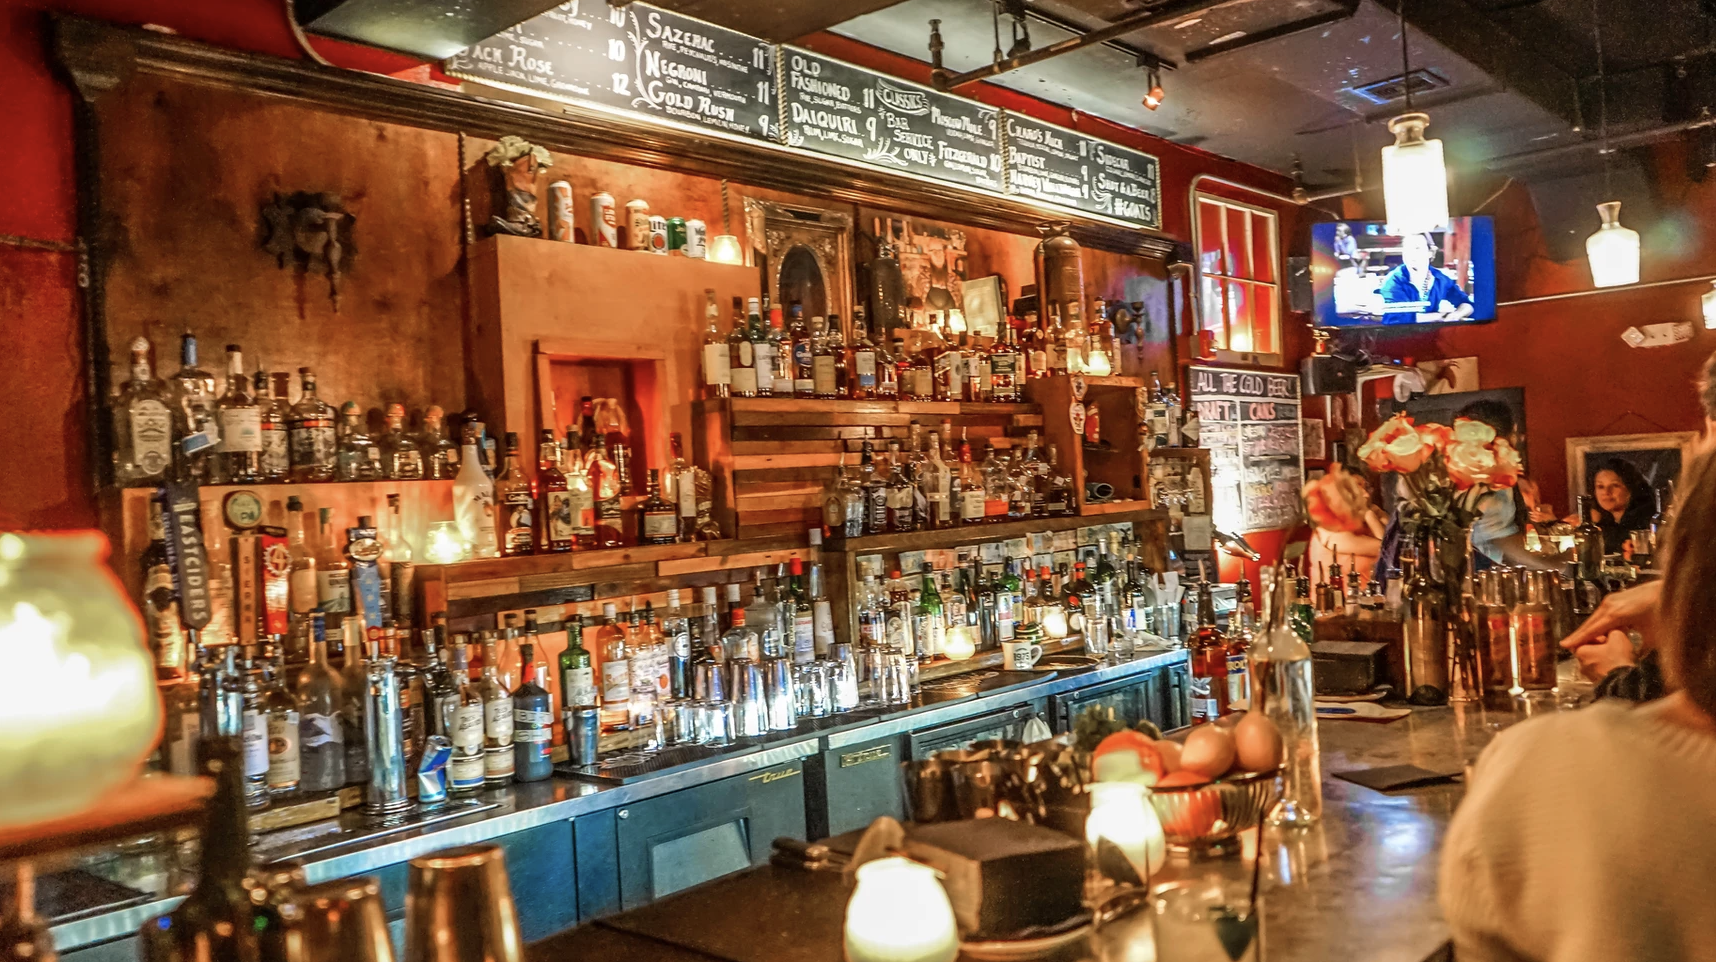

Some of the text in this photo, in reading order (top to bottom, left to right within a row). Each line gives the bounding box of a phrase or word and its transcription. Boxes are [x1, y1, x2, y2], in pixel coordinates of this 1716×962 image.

[608, 39, 626, 61] 10
[646, 12, 764, 69] SAZERAC 11
[508, 45, 554, 75] ROSE
[612, 73, 631, 96] 12
[645, 49, 769, 105] NEGRONI 11
[791, 55, 821, 77] OLD
[790, 70, 874, 109] FASHIONED 11
[648, 80, 769, 136] GOLD RUSH 9
[791, 102, 877, 142] DAIQUIRI 9
[886, 112, 910, 130] BAR
[989, 119, 997, 140] 9
[893, 129, 934, 149] SERVICE
[904, 148, 929, 164] ONLY
[989, 153, 1001, 173] 10
[1008, 146, 1046, 169] BAPTIST
[1081, 165, 1088, 181] 9
[1191, 371, 1217, 392] ALL
[1219, 373, 1238, 393] THE
[1240, 374, 1264, 395] COLD
[1197, 401, 1276, 420] DRAFT CANS
[179, 514, 208, 620] EASTCIDERS
